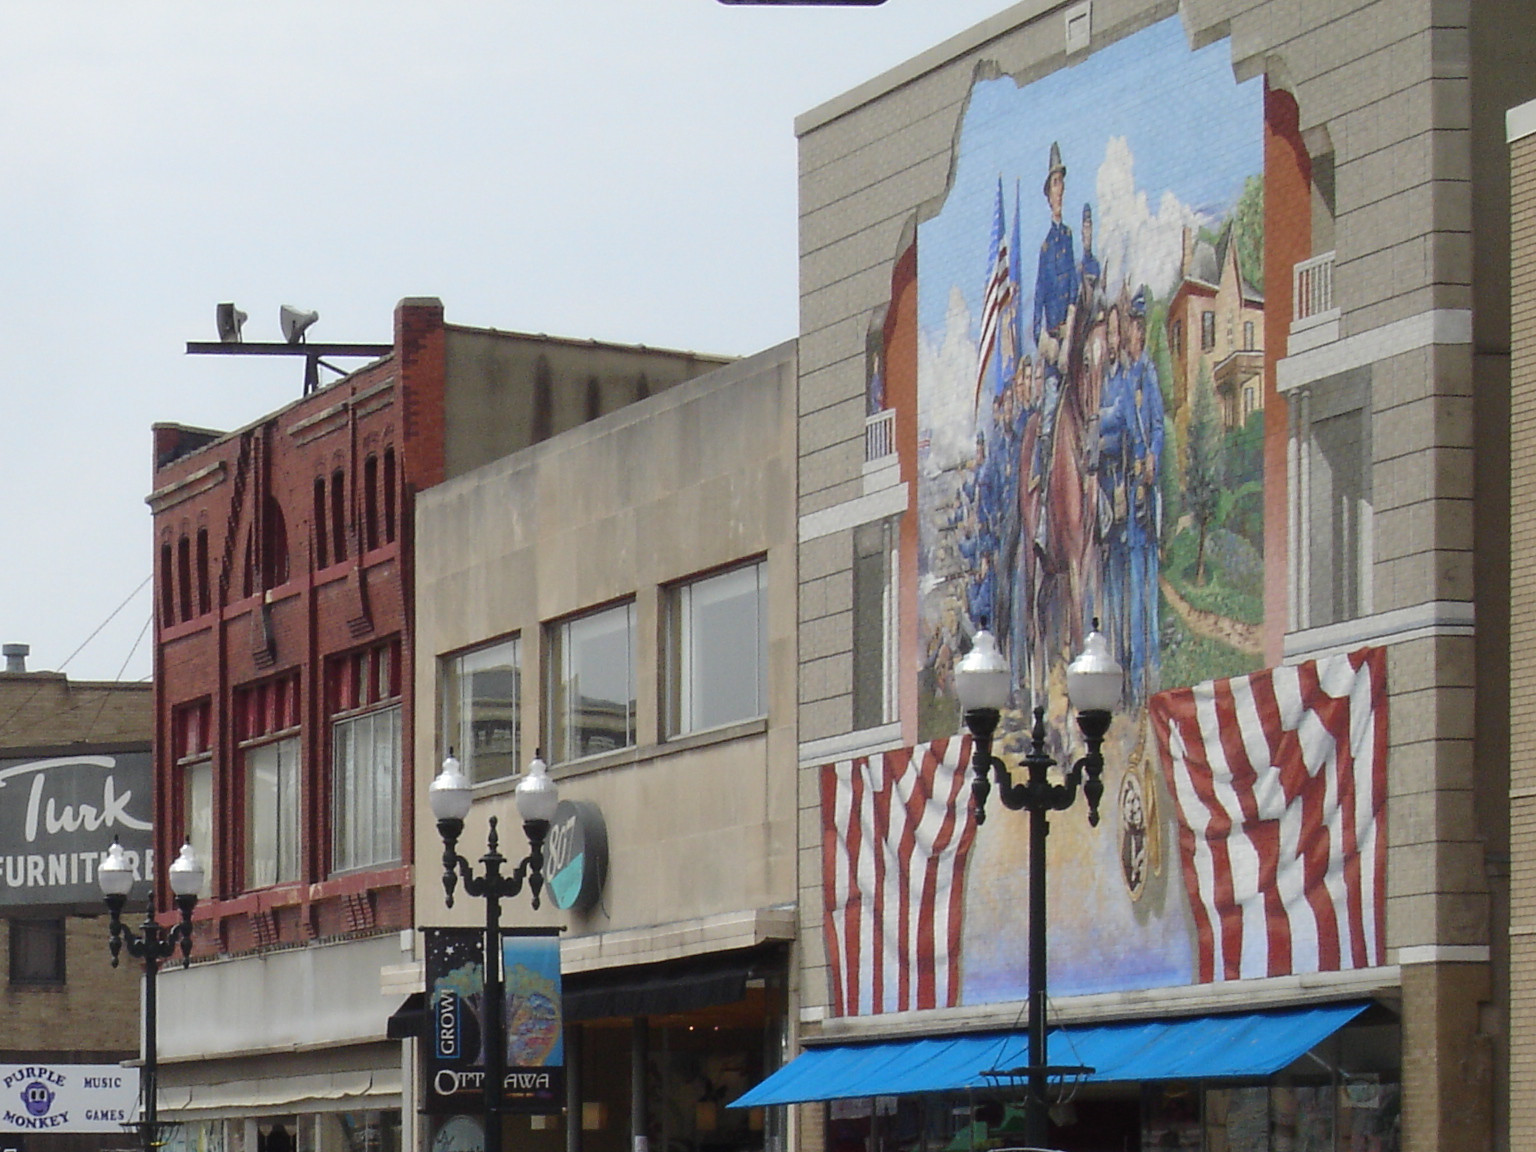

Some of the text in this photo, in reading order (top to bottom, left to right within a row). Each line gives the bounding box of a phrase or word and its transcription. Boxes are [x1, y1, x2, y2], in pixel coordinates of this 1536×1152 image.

[546, 815, 576, 883] 807
[440, 989, 455, 1055] GROW!
[3, 1067, 66, 1088] PURPLE
[84, 1077, 122, 1089] MUSIC
[434, 1069, 550, 1095] OTTAWA
[3, 1110, 69, 1128] MONKEY
[85, 1110, 125, 1121] GAMES
